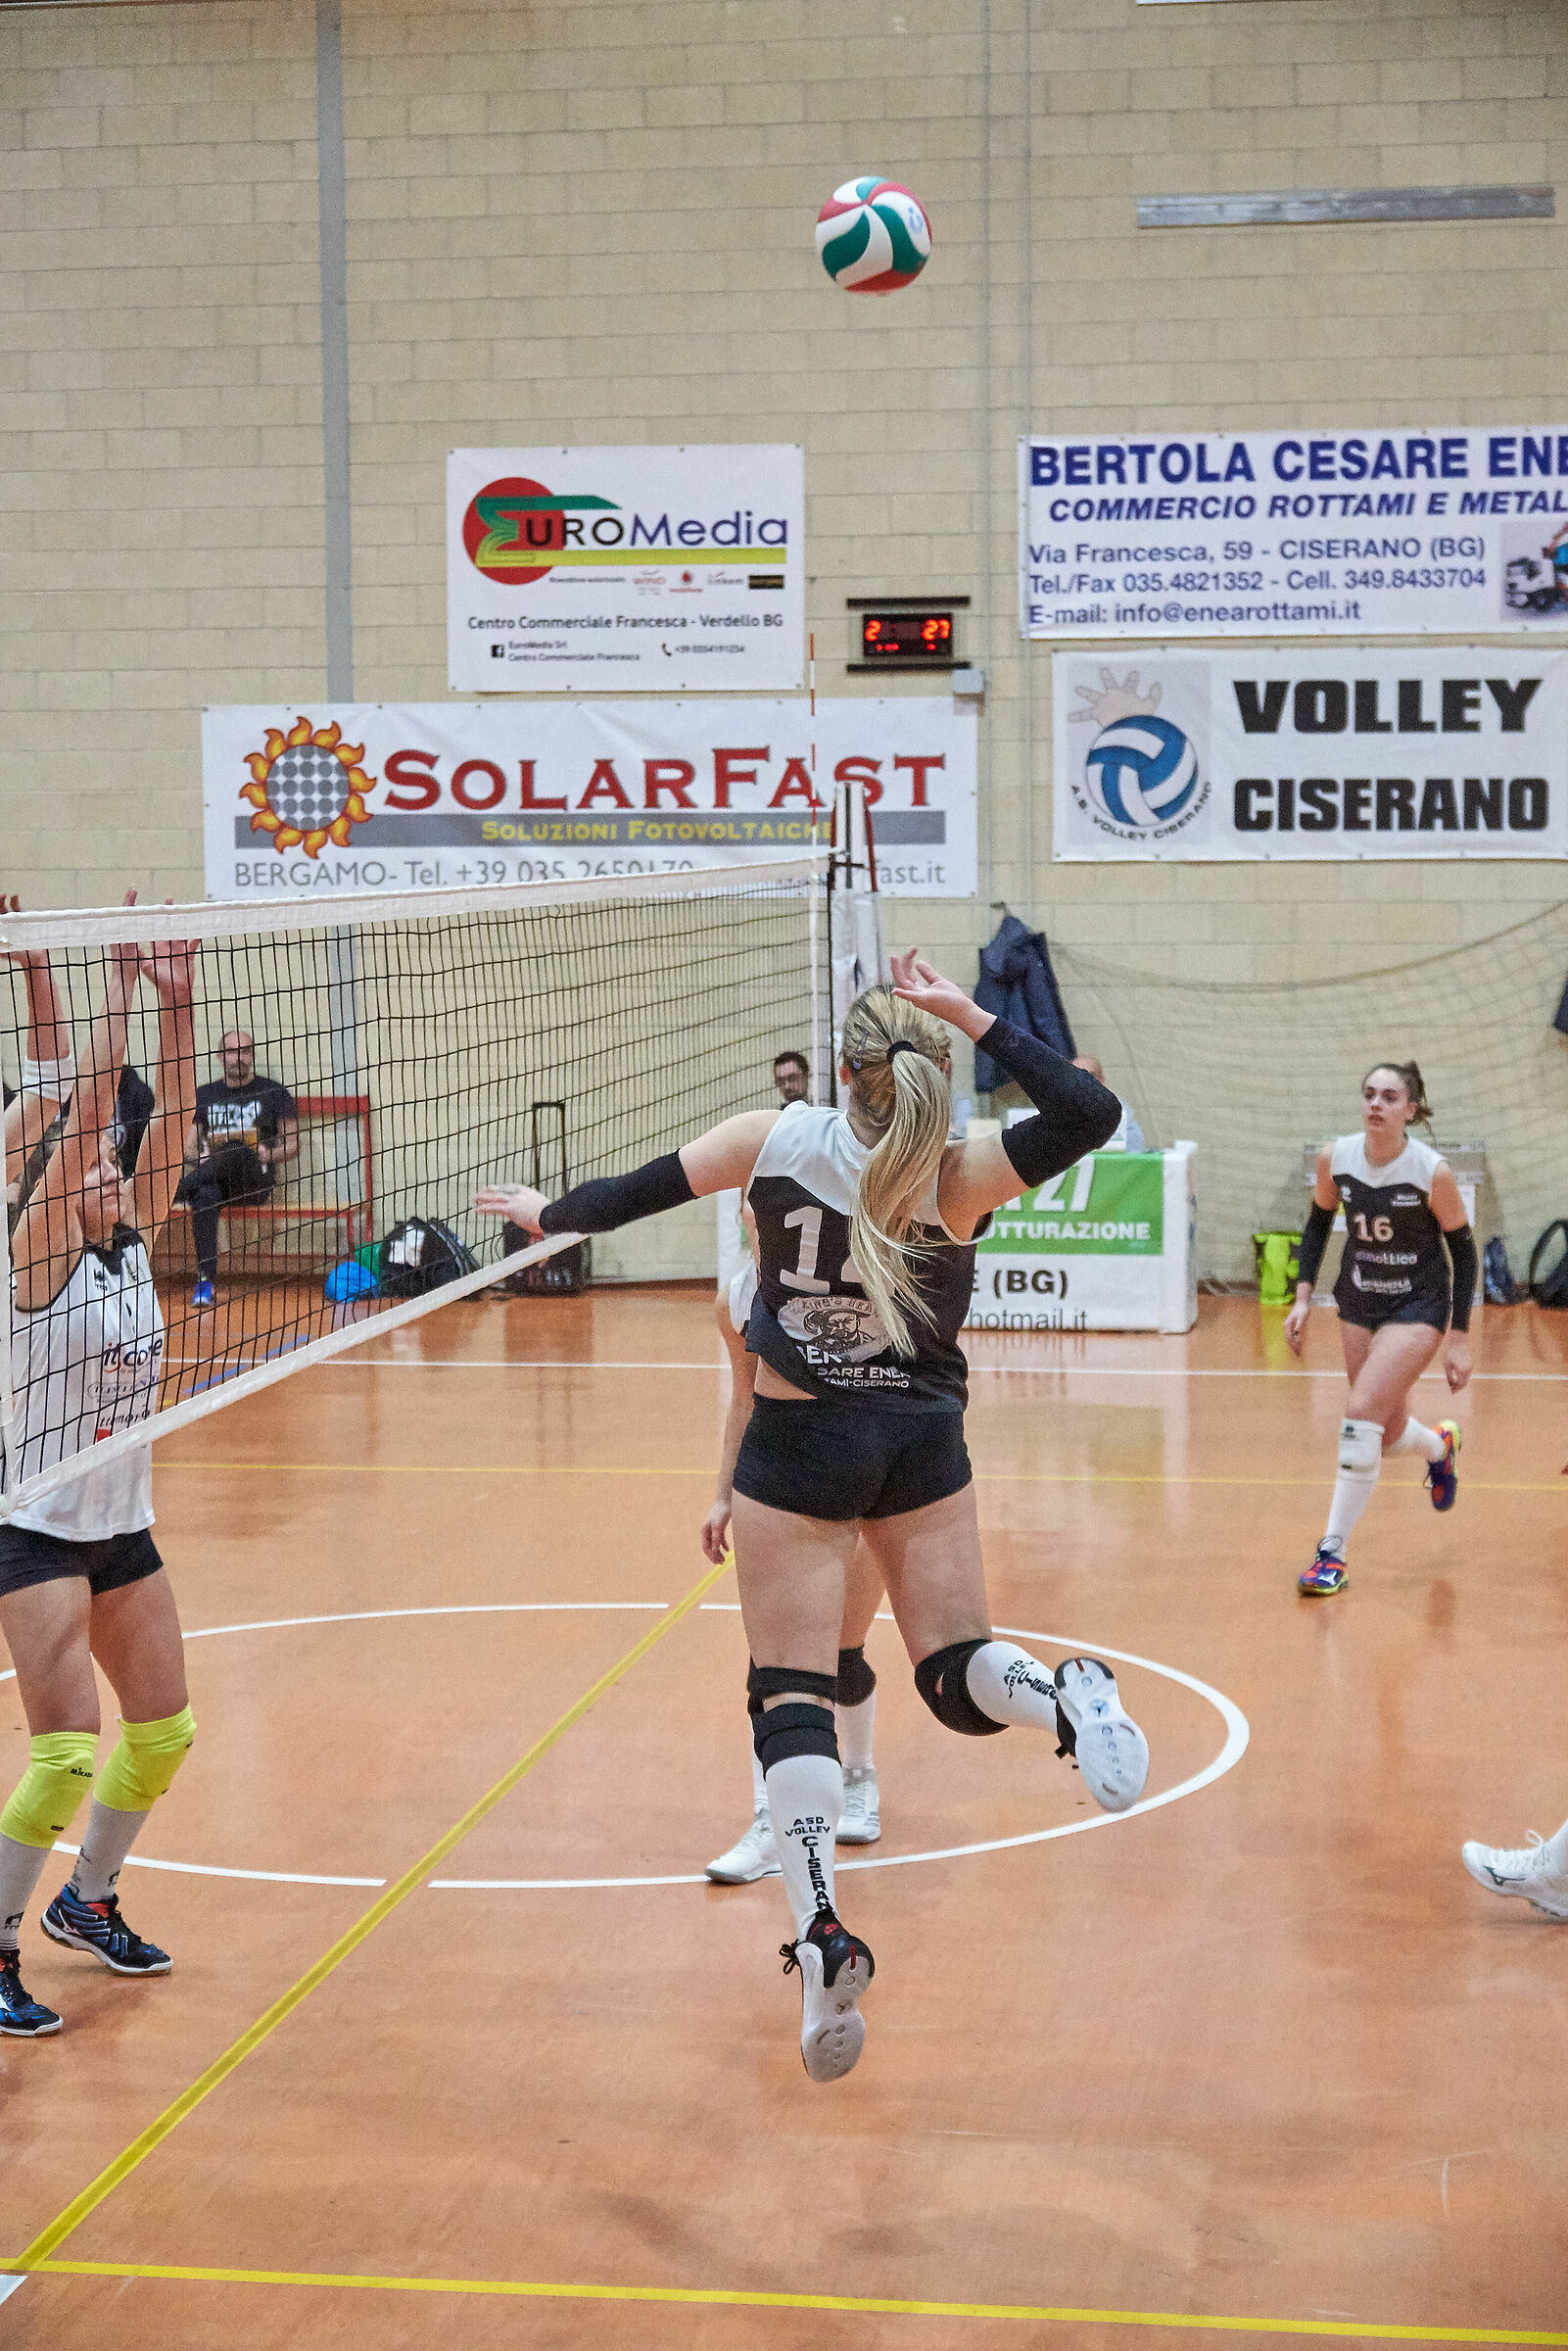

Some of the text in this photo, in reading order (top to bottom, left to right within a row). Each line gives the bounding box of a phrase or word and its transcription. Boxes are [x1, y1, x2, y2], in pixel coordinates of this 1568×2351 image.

[1030, 442, 1257, 487] BERTOLA
[1273, 437, 1468, 482] CESARE
[1049, 495, 1257, 522] COMMERCIO
[1267, 493, 1416, 518] ROTTAMI
[1427, 492, 1449, 515] E
[1029, 544, 1066, 564] Via
[1075, 543, 1214, 564] Francesca,
[1223, 541, 1254, 561] 59
[1280, 538, 1421, 559] CISERANO
[1431, 537, 1485, 561] (BG)
[1029, 574, 1117, 596] Tel./Fax
[1122, 571, 1263, 593] 035.4821352
[1287, 570, 1337, 590] Cell.
[1345, 568, 1486, 590] 349.8433704
[468, 616, 516, 630] Centro
[518, 615, 613, 629] Commerciale
[616, 615, 688, 629] Francesca
[699, 614, 759, 628] Verdello
[763, 614, 784, 627] BG
[1029, 600, 1362, 625] E-mail: info@enearottami.it
[865, 619, 882, 642] 2
[1232, 677, 1544, 735] VOLLEY
[1234, 778, 1549, 833] CISERANO
[482, 820, 618, 840] SOLUZIONI
[404, 861, 448, 886] Tel.
[456, 861, 506, 885] +39
[518, 860, 565, 883] 035
[1354, 1213, 1394, 1242] 16
[993, 1270, 1068, 1300] (BG)
[848, 1298, 876, 1314] HEA
[784, 1826, 831, 1837] VOLLEY
[793, 1816, 825, 1827] ASD
